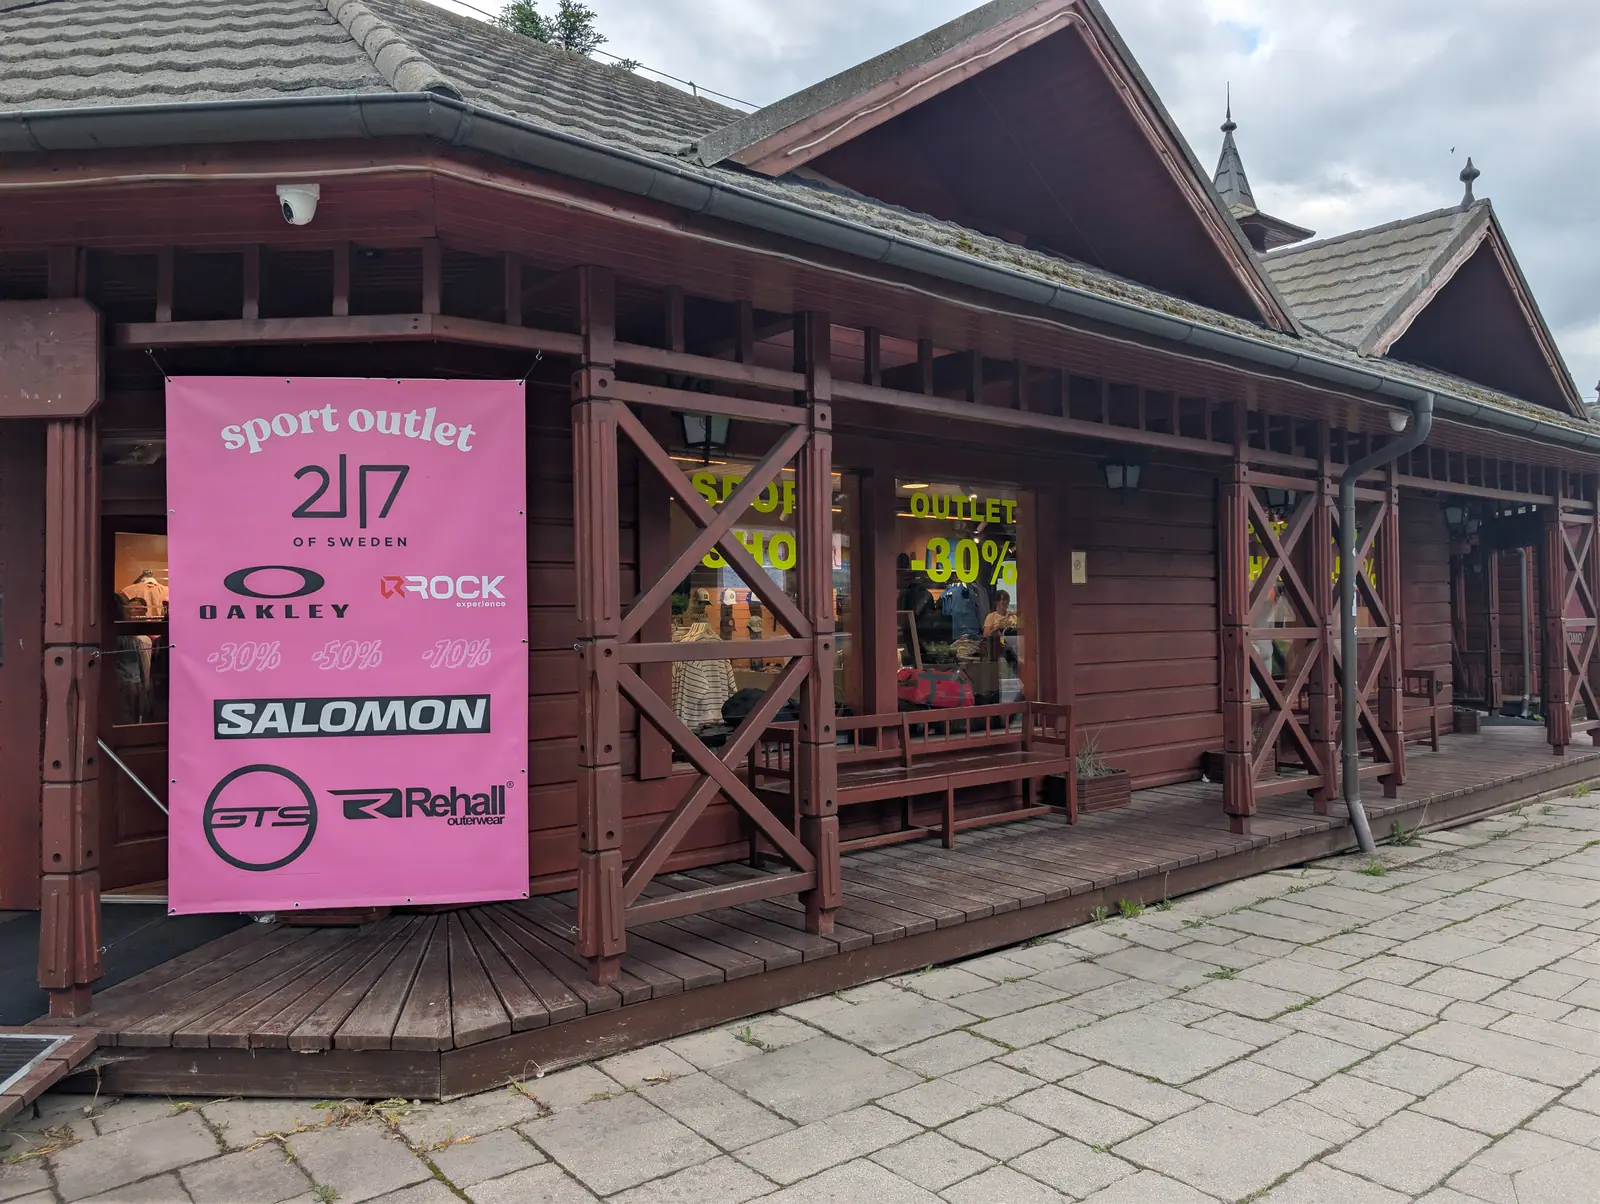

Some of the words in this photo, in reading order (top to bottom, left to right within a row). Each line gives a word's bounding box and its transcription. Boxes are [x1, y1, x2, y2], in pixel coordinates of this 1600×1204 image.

[220, 403, 340, 453] sport
[347, 407, 477, 452] outlet
[910, 491, 1017, 524] OUTLET
[293, 537, 317, 548] OF
[327, 537, 408, 548] SWEDEN
[911, 537, 1018, 586] -30%
[199, 603, 350, 620] OAKLEY
[456, 600, 507, 609] experience
[207, 641, 282, 673] -30%
[312, 640, 383, 671] -50%
[422, 638, 492, 669] -70%
[216, 698, 487, 736] SALOMON
[211, 804, 312, 829] GTS
[405, 785, 506, 817] Rehall
[447, 815, 505, 826] outerwear
